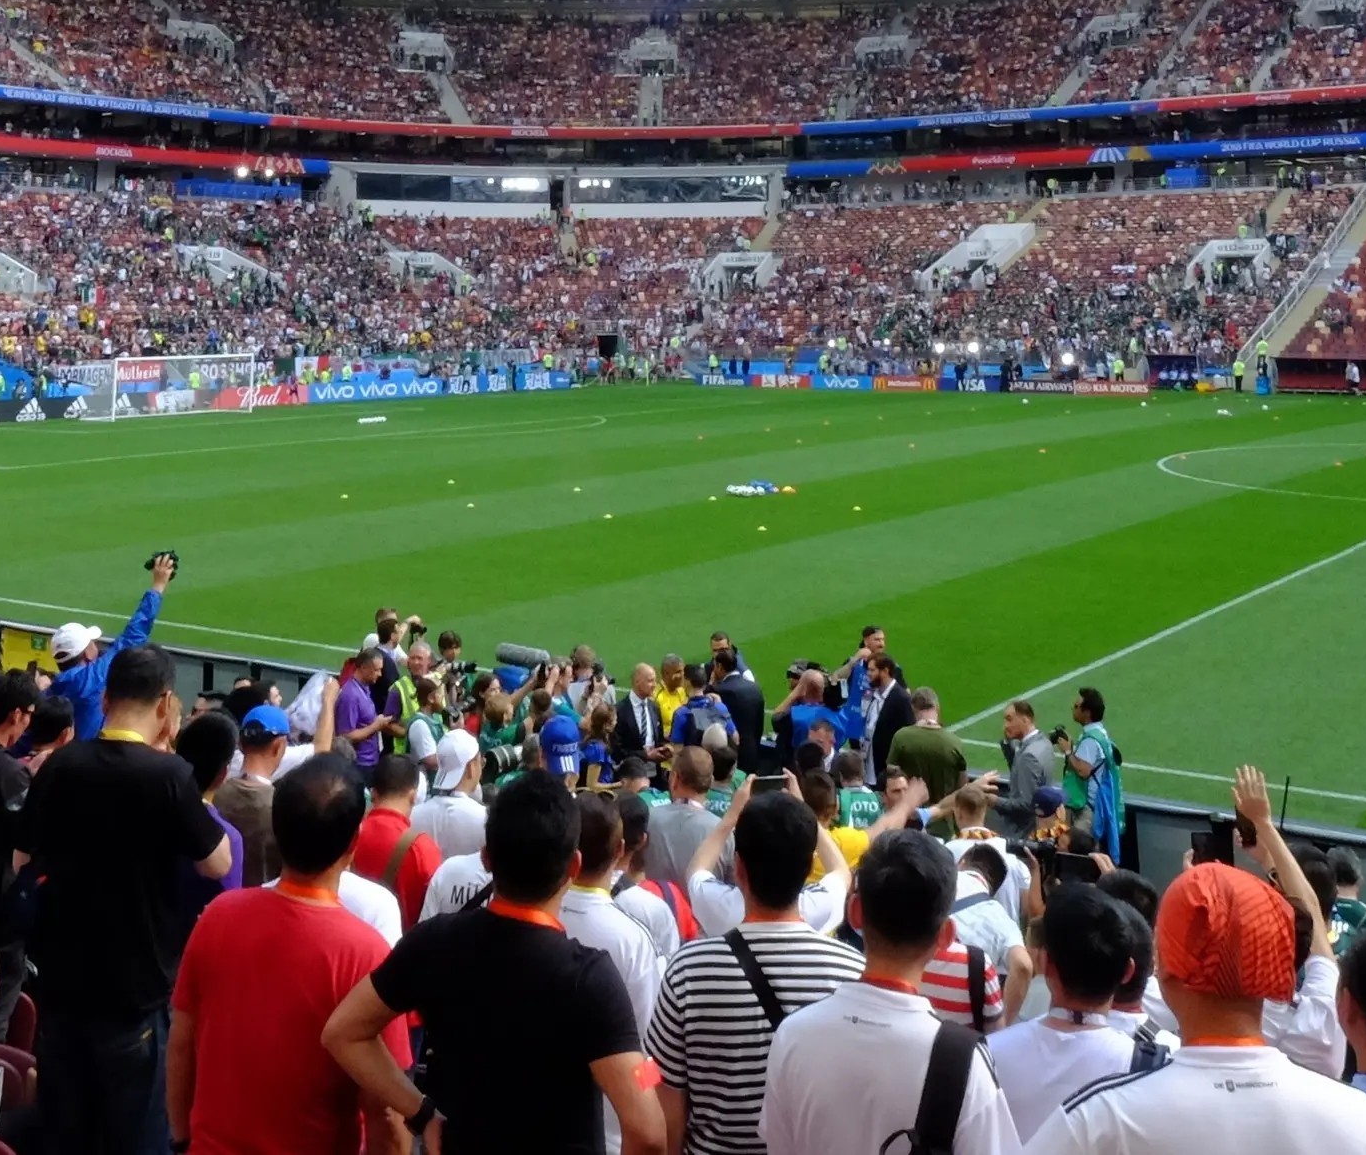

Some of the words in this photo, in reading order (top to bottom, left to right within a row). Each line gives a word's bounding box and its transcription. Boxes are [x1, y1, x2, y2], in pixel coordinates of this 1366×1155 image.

[1243, 141, 1265, 151] FIFA
[1265, 139, 1300, 150] WORLD
[1300, 137, 1322, 148] CUP
[1322, 135, 1361, 147] RUSSIA
[95, 146, 133, 159] МОСКВА
[316, 383, 355, 400] vivo
[359, 380, 398, 398] vivo
[401, 378, 438, 395] vivo
[1035, 380, 1073, 392] AIRWAYS
[1093, 383, 1109, 393] KIA
[1109, 383, 1149, 394] MOTORS
[237, 384, 282, 409] Bud
